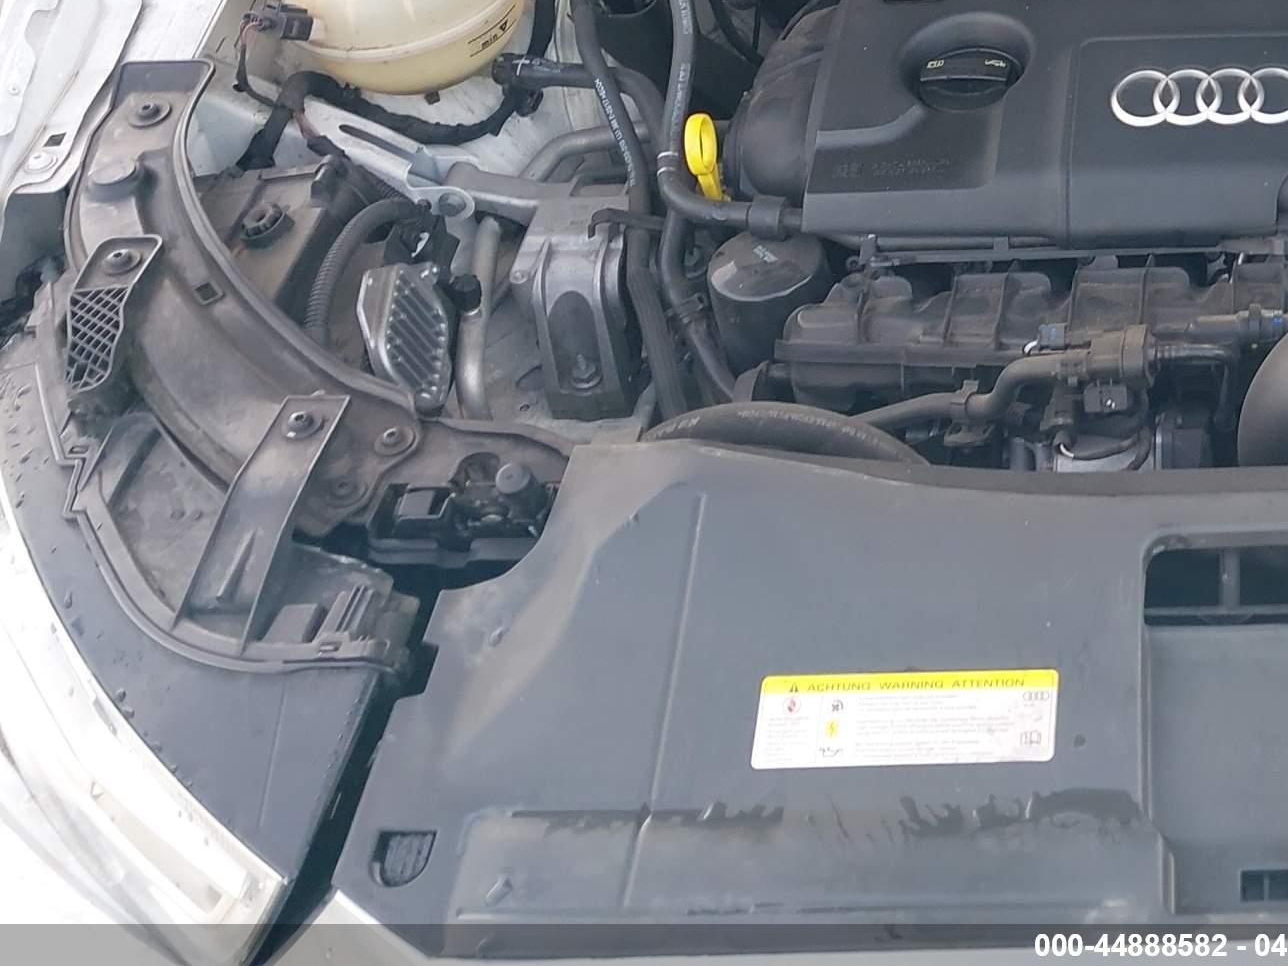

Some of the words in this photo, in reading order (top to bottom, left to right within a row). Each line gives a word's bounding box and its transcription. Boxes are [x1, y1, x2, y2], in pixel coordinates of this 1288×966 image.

[481, 33, 499, 52] min
[807, 682, 872, 692] ACHTUNG
[879, 680, 944, 690] WARNING
[951, 678, 1026, 688] ATTENTION
